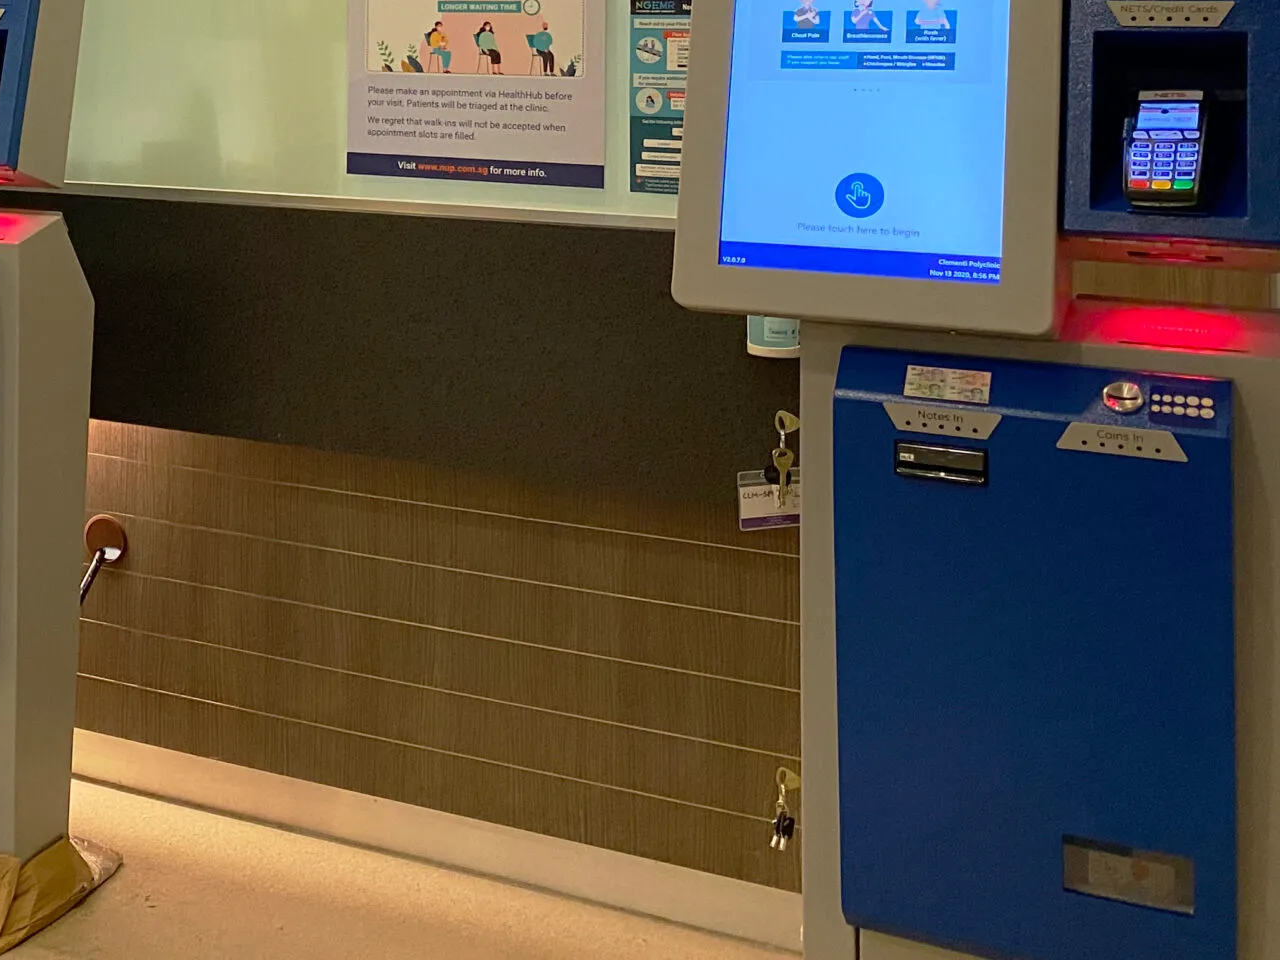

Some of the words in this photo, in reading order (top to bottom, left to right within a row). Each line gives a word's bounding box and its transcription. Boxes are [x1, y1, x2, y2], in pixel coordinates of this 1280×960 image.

[441, 3, 468, 11] LONGER
[469, 3, 499, 11] WAITING
[500, 2, 518, 11] TIME
[635, 1, 675, 10] NGEMR
[1121, 4, 1184, 14] NETS/Credit
[1188, 4, 1218, 14] Cards
[368, 86, 394, 95] Please
[431, 89, 483, 98] appointment
[485, 90, 497, 98] via
[498, 91, 543, 100] HealthHub
[544, 92, 573, 100] before
[367, 99, 385, 107] your
[406, 100, 439, 108] Patients
[441, 101, 455, 109] will
[456, 101, 467, 109] be
[468, 102, 498, 112] triaged
[509, 103, 523, 112] the
[525, 103, 550, 113] clinic.
[367, 116, 380, 124] We
[381, 117, 405, 127] regret
[406, 117, 422, 126] that
[458, 120, 473, 128] will
[474, 121, 488, 129] not
[489, 121, 500, 129] be
[502, 123, 541, 132] accepted
[542, 124, 566, 132] when
[367, 128, 417, 138] appointment
[418, 130, 438, 139] slots
[397, 160, 416, 170] Visit
[418, 162, 488, 176] www.nup.com.sg
[490, 165, 503, 174] for
[504, 167, 527, 176] more
[528, 167, 548, 177] info.
[797, 223, 825, 233] Please
[827, 224, 855, 234] touch
[857, 226, 878, 235] here
[880, 227, 890, 236] to
[892, 228, 920, 238] begin
[938, 258, 968, 267] Clementi
[968, 260, 1000, 270] Polyclinic
[929, 269, 943, 277] Nov
[918, 410, 950, 421] Notes
[953, 414, 964, 423] In
[1096, 428, 1130, 441] Coins
[1133, 433, 1144, 442] In
